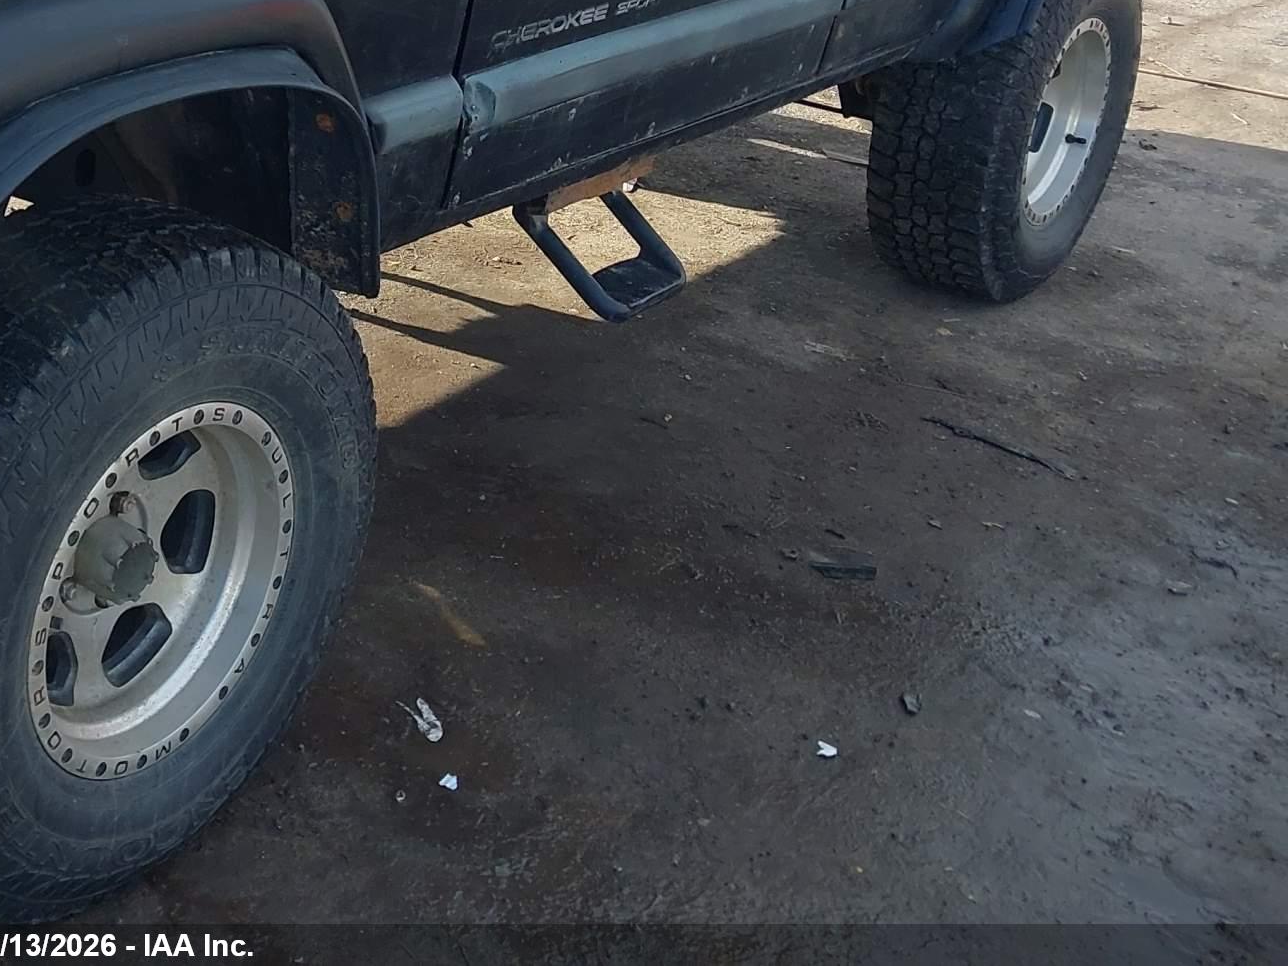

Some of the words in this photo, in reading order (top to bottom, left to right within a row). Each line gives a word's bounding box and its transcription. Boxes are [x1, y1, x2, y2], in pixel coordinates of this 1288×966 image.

[490, 2, 610, 52] CHEROKEE
[34, 407, 225, 774] MOTORSPORTS
[233, 449, 293, 674] ULTRA
